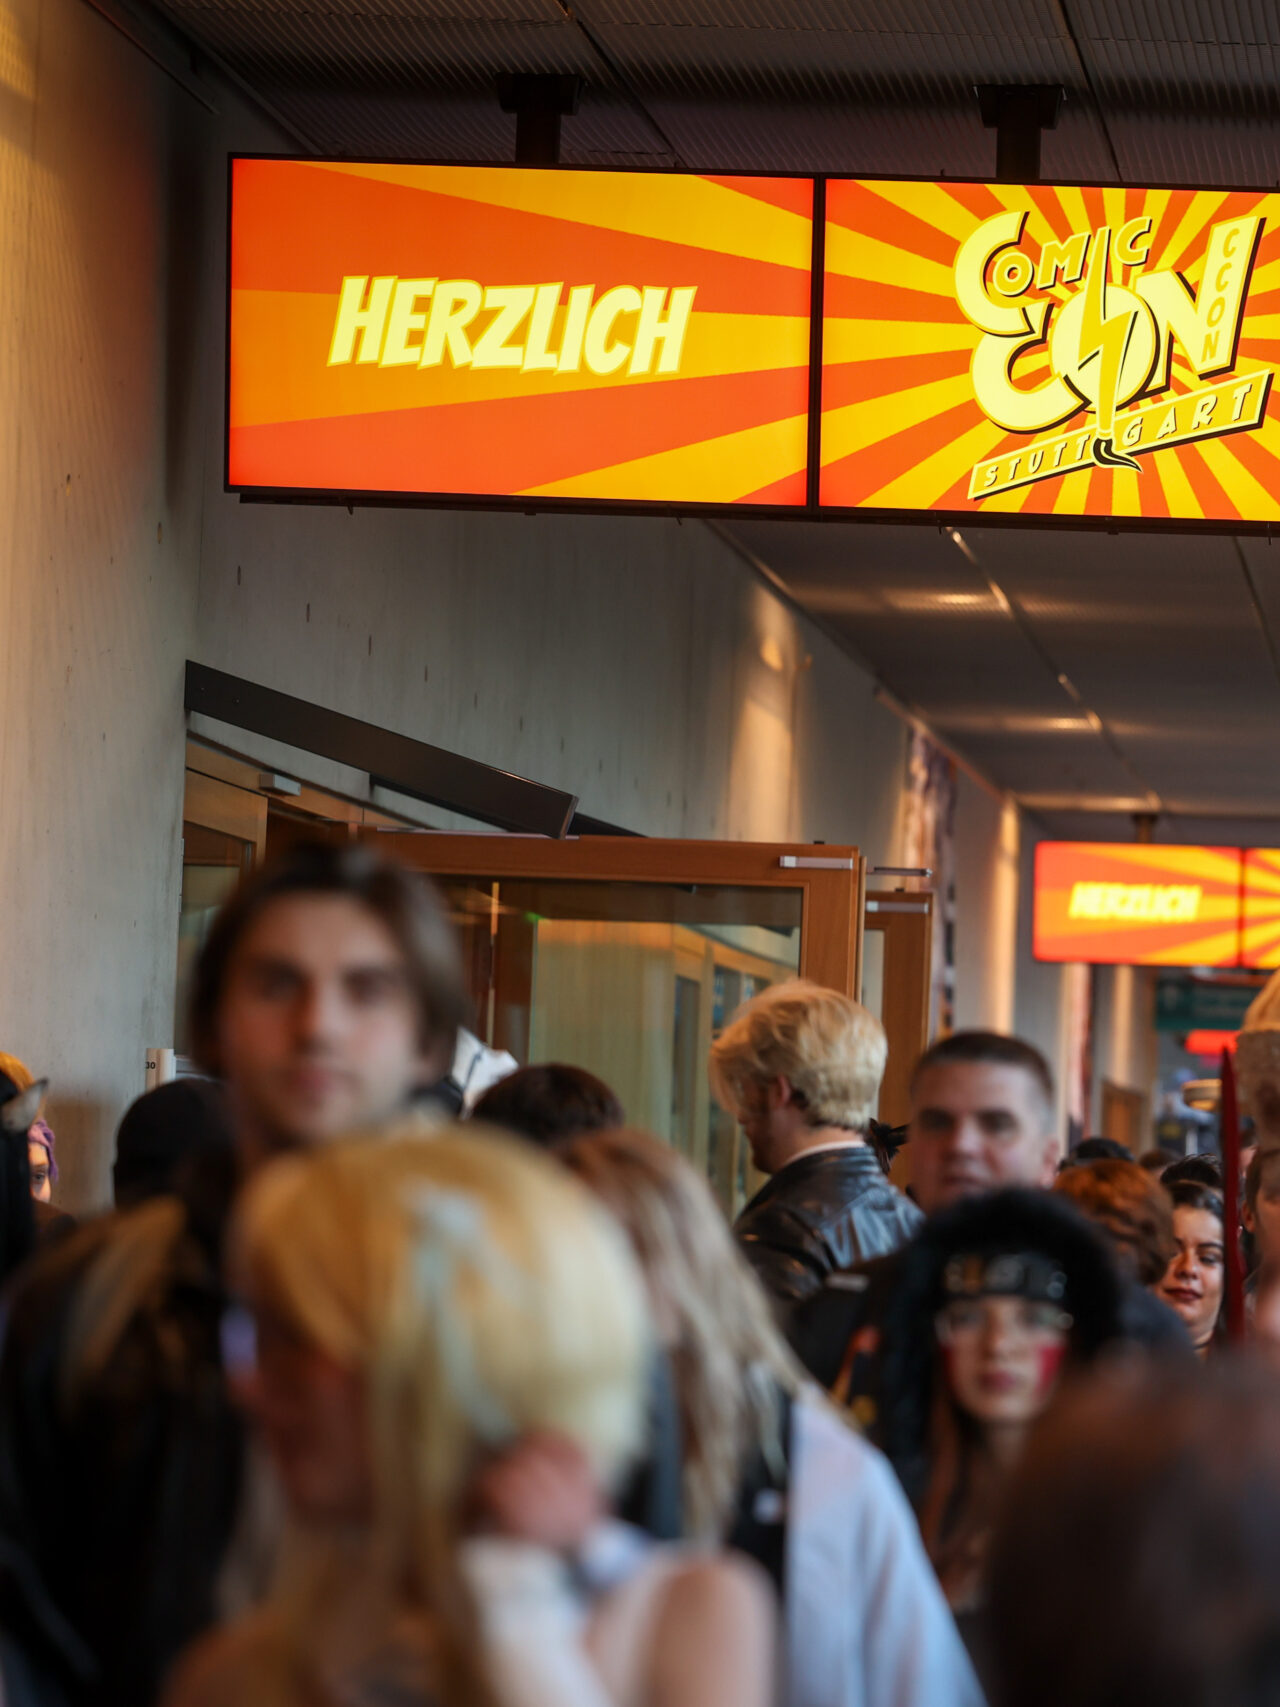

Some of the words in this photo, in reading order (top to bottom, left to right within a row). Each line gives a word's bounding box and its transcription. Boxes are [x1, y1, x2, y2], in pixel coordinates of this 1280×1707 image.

[327, 275, 698, 378] HERZLICH
[954, 211, 1152, 337] COMIC
[1201, 228, 1240, 363] CCON
[983, 383, 1253, 488] STUTTGART
